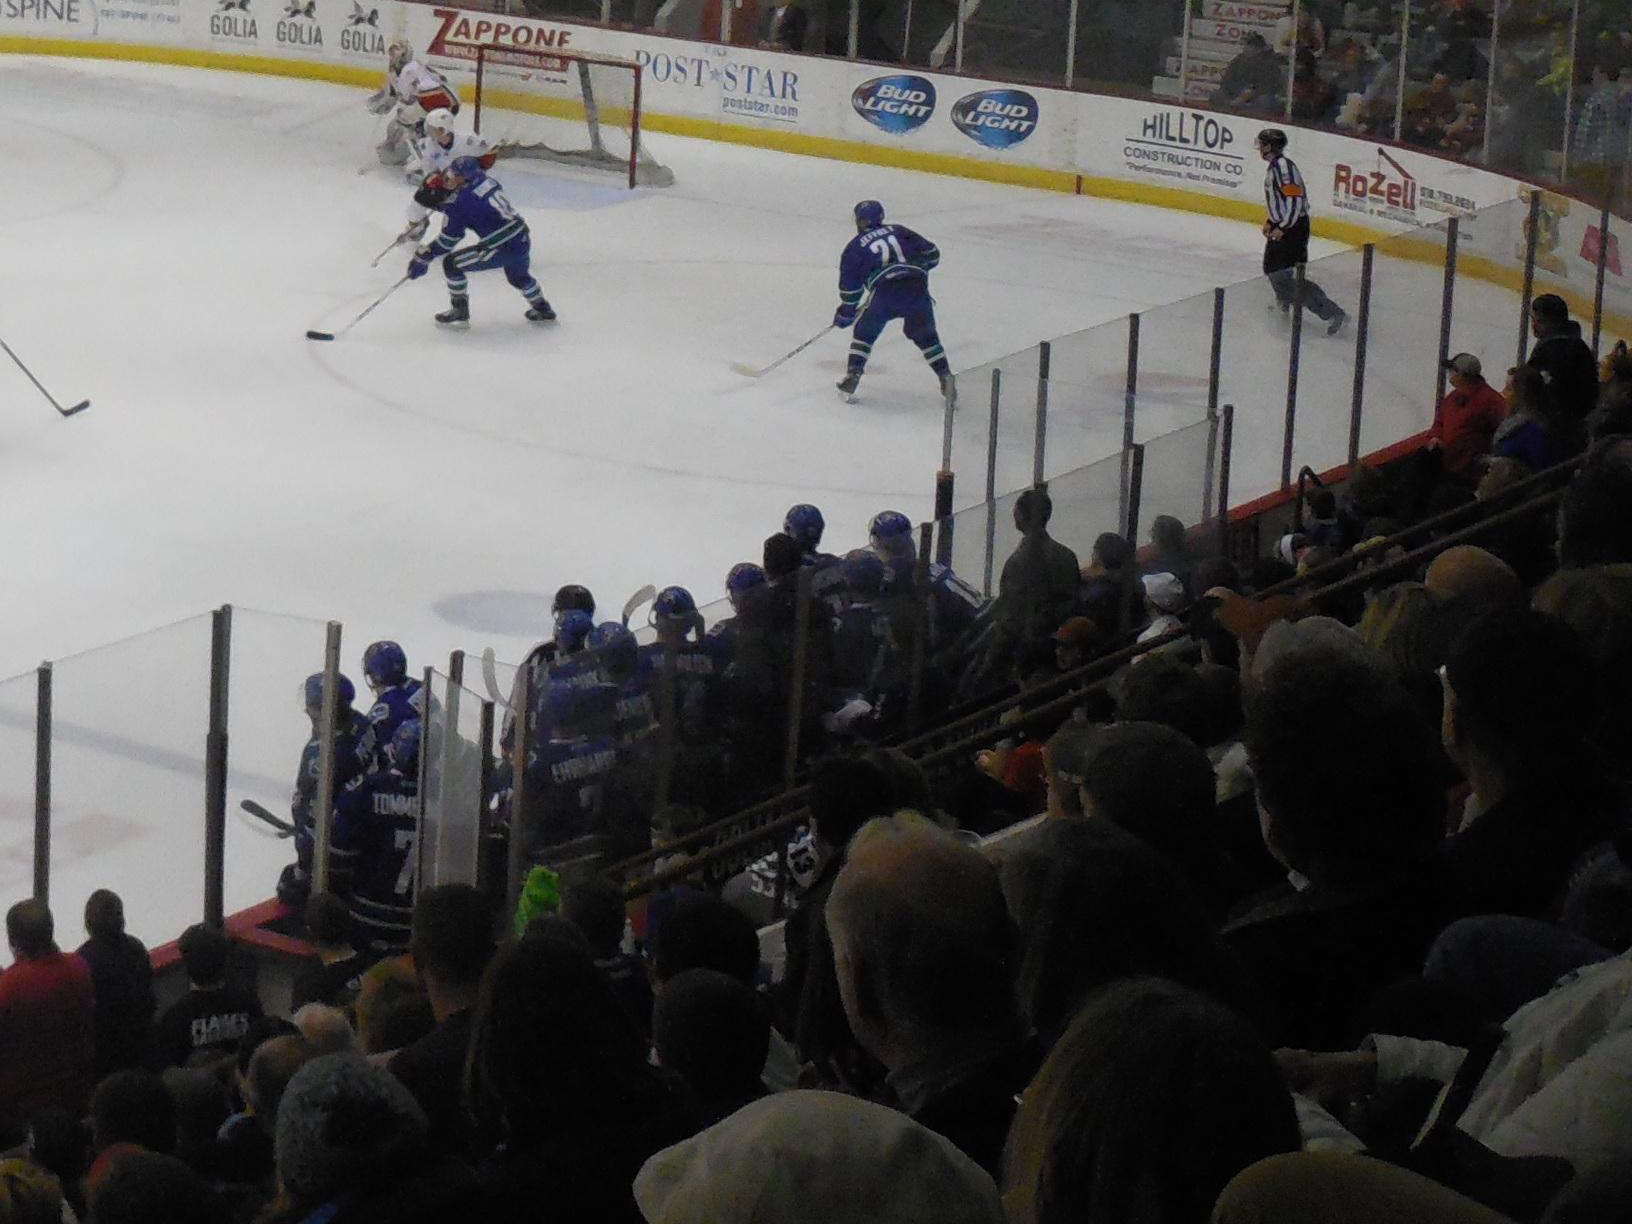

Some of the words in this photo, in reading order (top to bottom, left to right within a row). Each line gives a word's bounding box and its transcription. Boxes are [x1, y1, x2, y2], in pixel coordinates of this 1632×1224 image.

[210, 13, 259, 39] GOLIA
[276, 20, 324, 47] GOLIA
[427, 9, 574, 55] ZAPPONE
[340, 29, 386, 56] GOLIA
[634, 48, 710, 88] POST
[721, 61, 799, 102] STAR
[721, 95, 799, 117] poststar.com
[876, 83, 928, 103] BUD
[862, 96, 933, 119] LIGHT
[976, 97, 1029, 119] BUD
[964, 111, 1035, 133] LIGHT
[1142, 111, 1234, 150] HILLTOP
[1123, 145, 1223, 171] CONSTRUCTION
[1224, 161, 1244, 176] CO
[1333, 162, 1418, 211] Rozell
